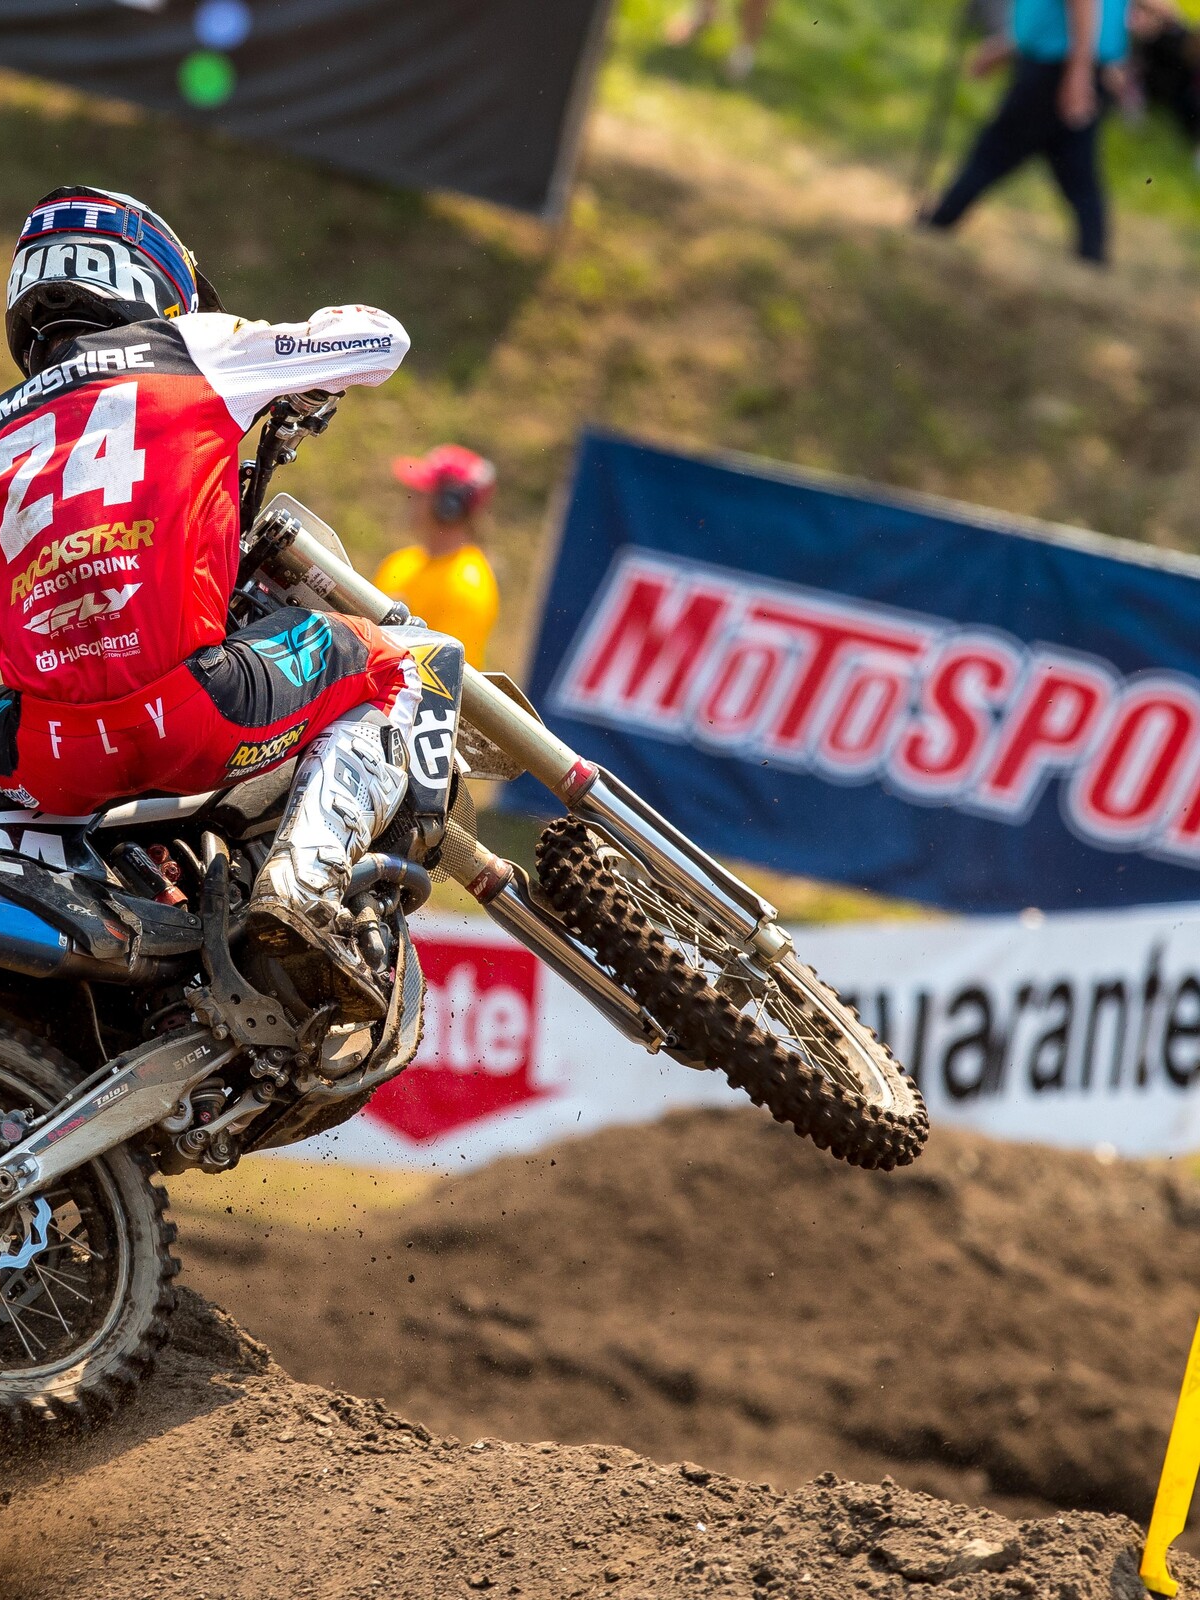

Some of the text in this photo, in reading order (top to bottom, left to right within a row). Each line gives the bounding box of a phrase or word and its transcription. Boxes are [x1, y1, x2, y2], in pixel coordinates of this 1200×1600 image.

[11, 519, 155, 606] ROCKSTAR
[23, 583, 143, 635] FLY
[50, 611, 121, 640] RACING
[59, 631, 140, 664] Husqvarna
[49, 697, 167, 760] FLY
[578, 568, 1200, 848] MOTOSPO
[842, 938, 1200, 1099] uarante
[173, 1045, 211, 1071] EXCEL
